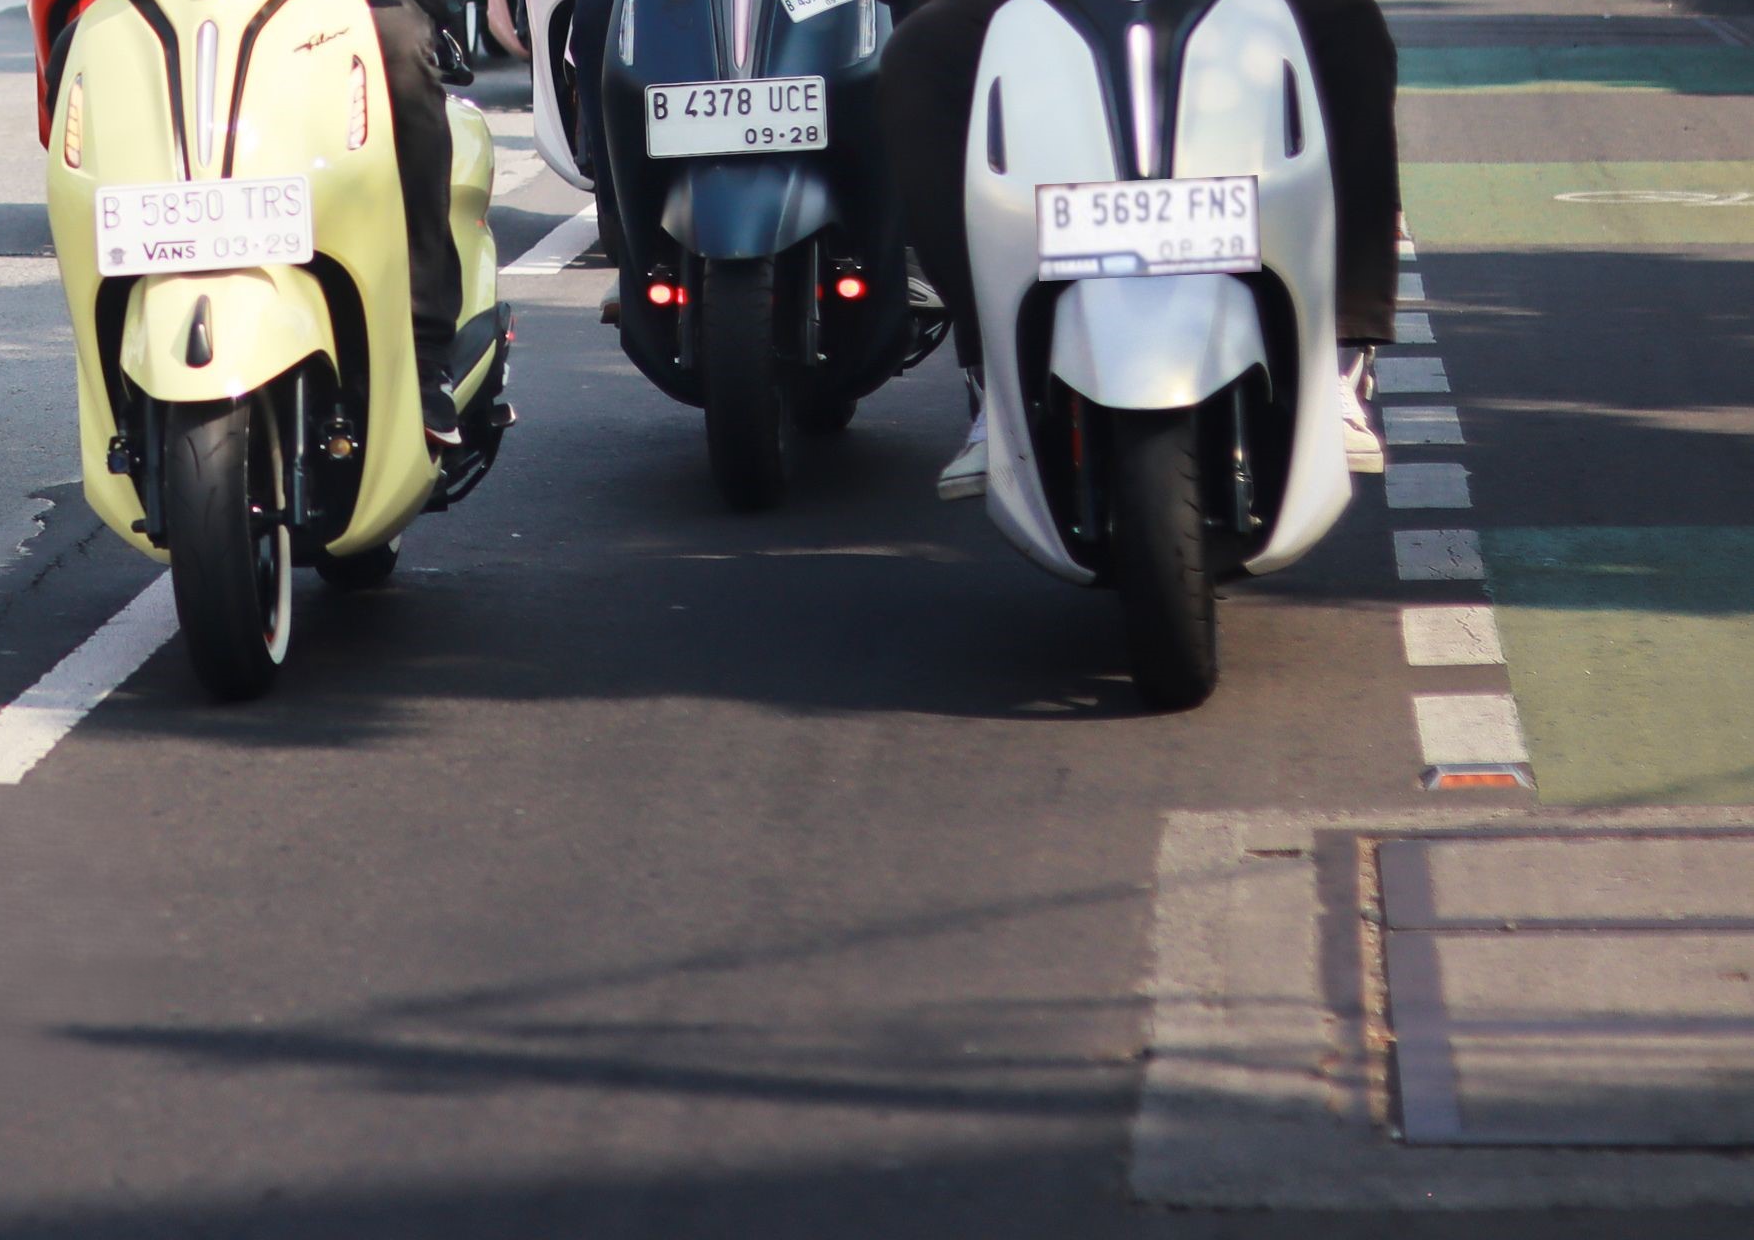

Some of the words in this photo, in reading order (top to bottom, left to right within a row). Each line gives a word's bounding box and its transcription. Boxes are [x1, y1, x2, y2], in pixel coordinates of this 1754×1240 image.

[785, 0, 795, 12] B
[653, 92, 669, 120] B
[685, 87, 752, 117] 4378
[768, 83, 819, 112] UCE
[102, 196, 121, 229] B
[142, 189, 224, 226] 5850
[241, 184, 302, 219] TRS
[1054, 195, 1071, 228] B
[1093, 189, 1172, 226] 5692
[1188, 186, 1247, 220] FNS
